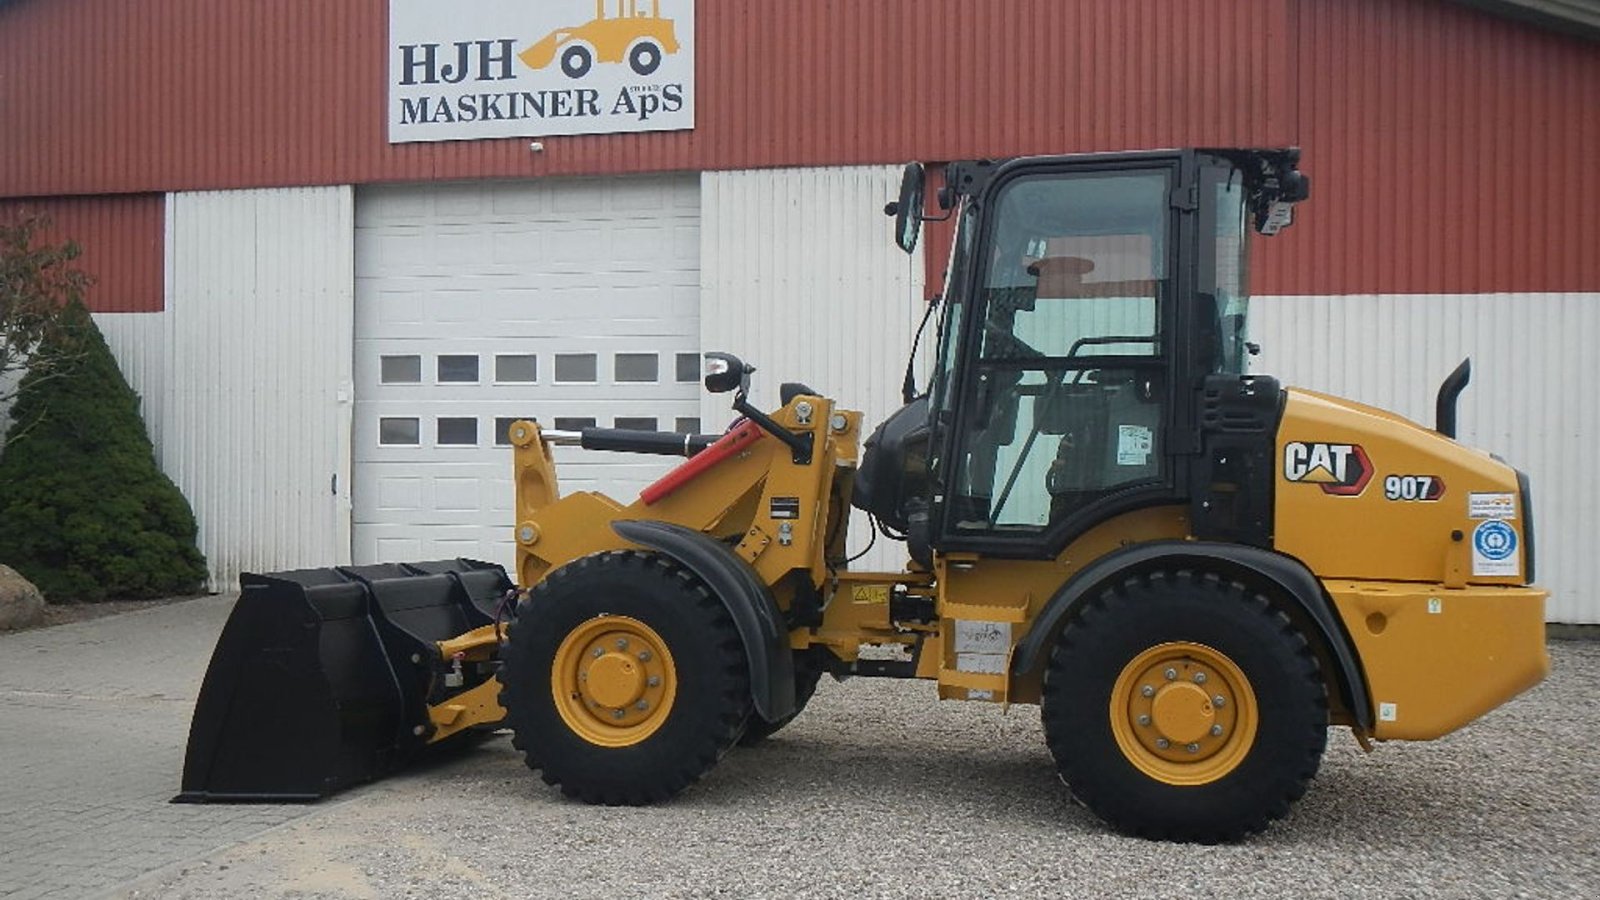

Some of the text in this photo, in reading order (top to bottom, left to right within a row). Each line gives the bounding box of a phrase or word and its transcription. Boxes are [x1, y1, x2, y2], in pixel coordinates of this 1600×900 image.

[398, 39, 518, 86] HJH
[400, 83, 683, 125] MASKINER ApS
[1285, 442, 1353, 483] CAT
[1385, 476, 1432, 500] 907
